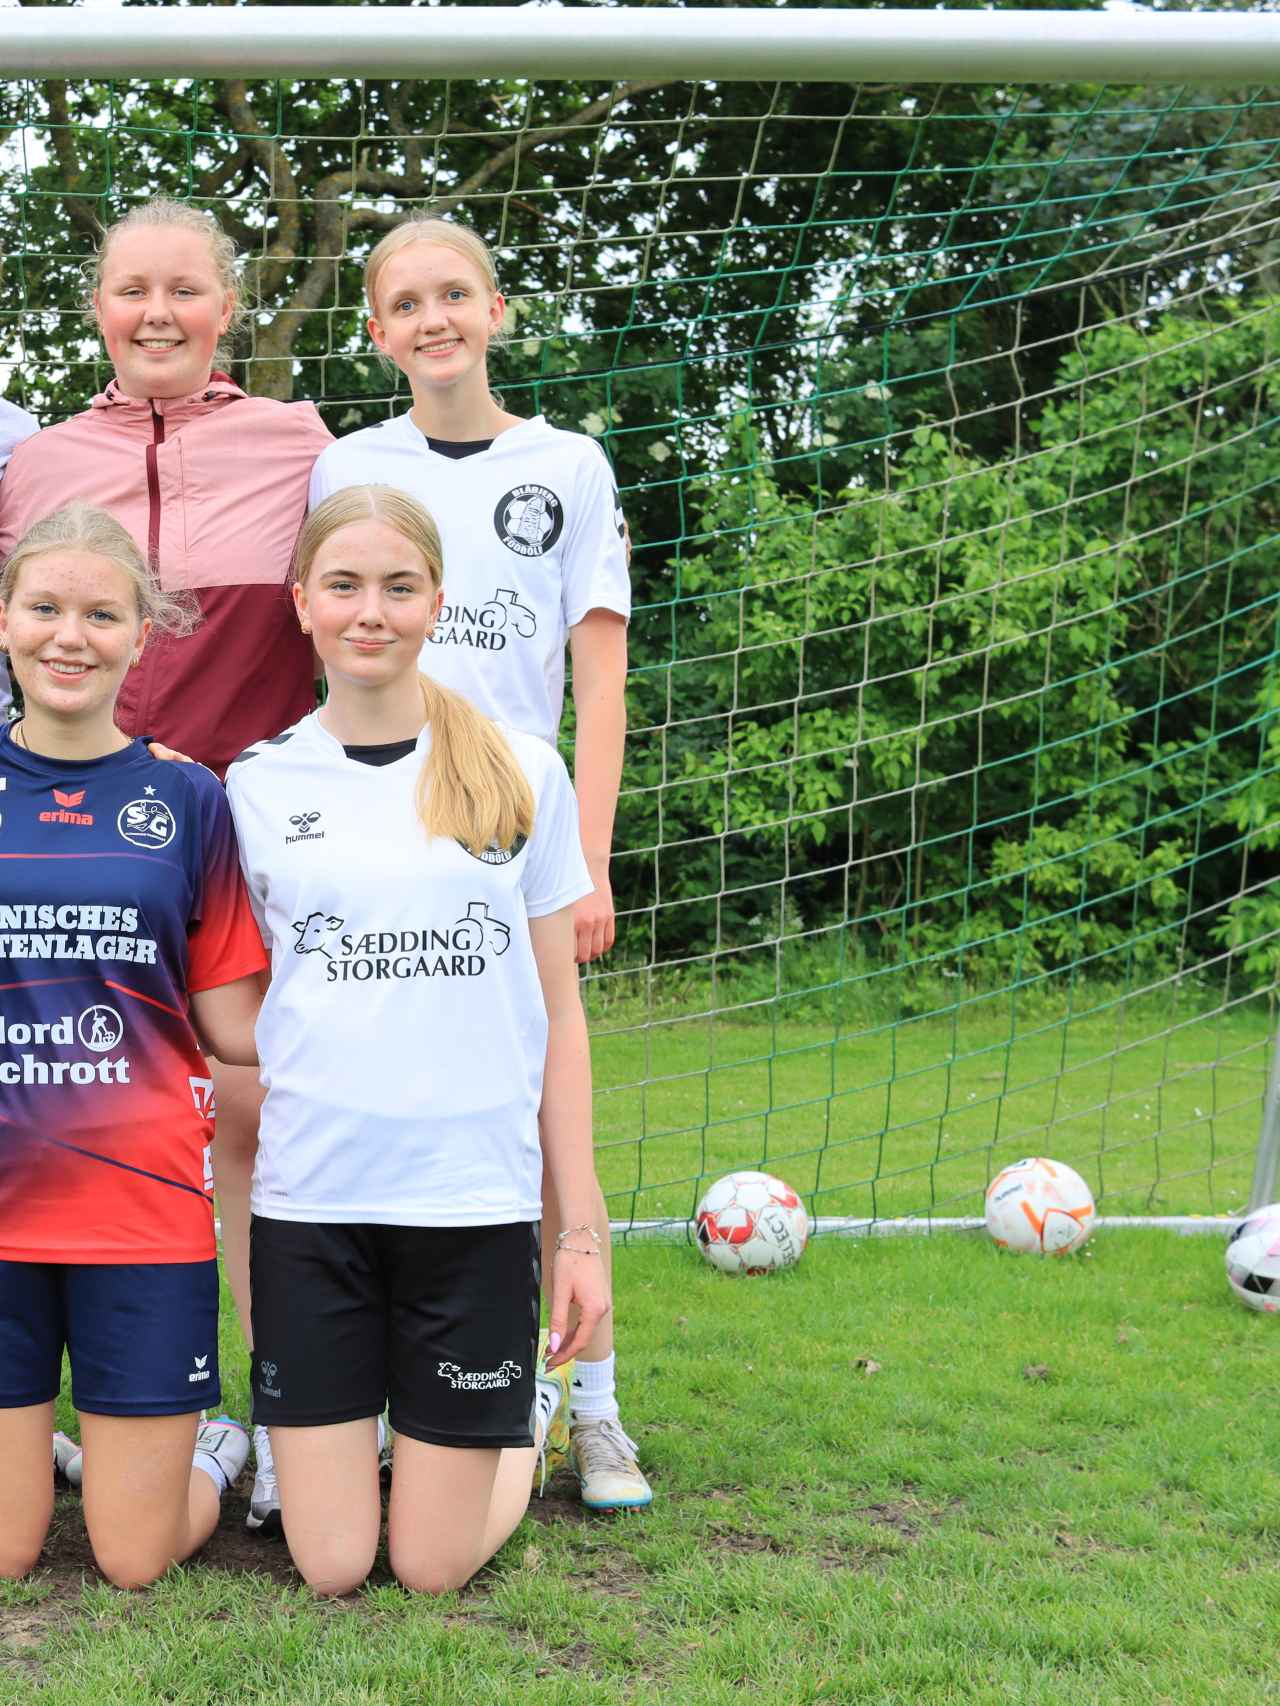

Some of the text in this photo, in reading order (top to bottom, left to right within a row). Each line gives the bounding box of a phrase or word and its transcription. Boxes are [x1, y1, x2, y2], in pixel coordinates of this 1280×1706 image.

[437, 605, 496, 629] DING
[425, 626, 506, 651] GAARD
[39, 809, 94, 826] erima
[285, 831, 325, 845] hummel
[340, 928, 471, 956] SÆDDING
[326, 955, 486, 982] STORGAARD
[188, 1370, 210, 1382] erima
[450, 1378, 511, 1390] STORGAARD
[457, 1370, 505, 1381] SÆDDING
